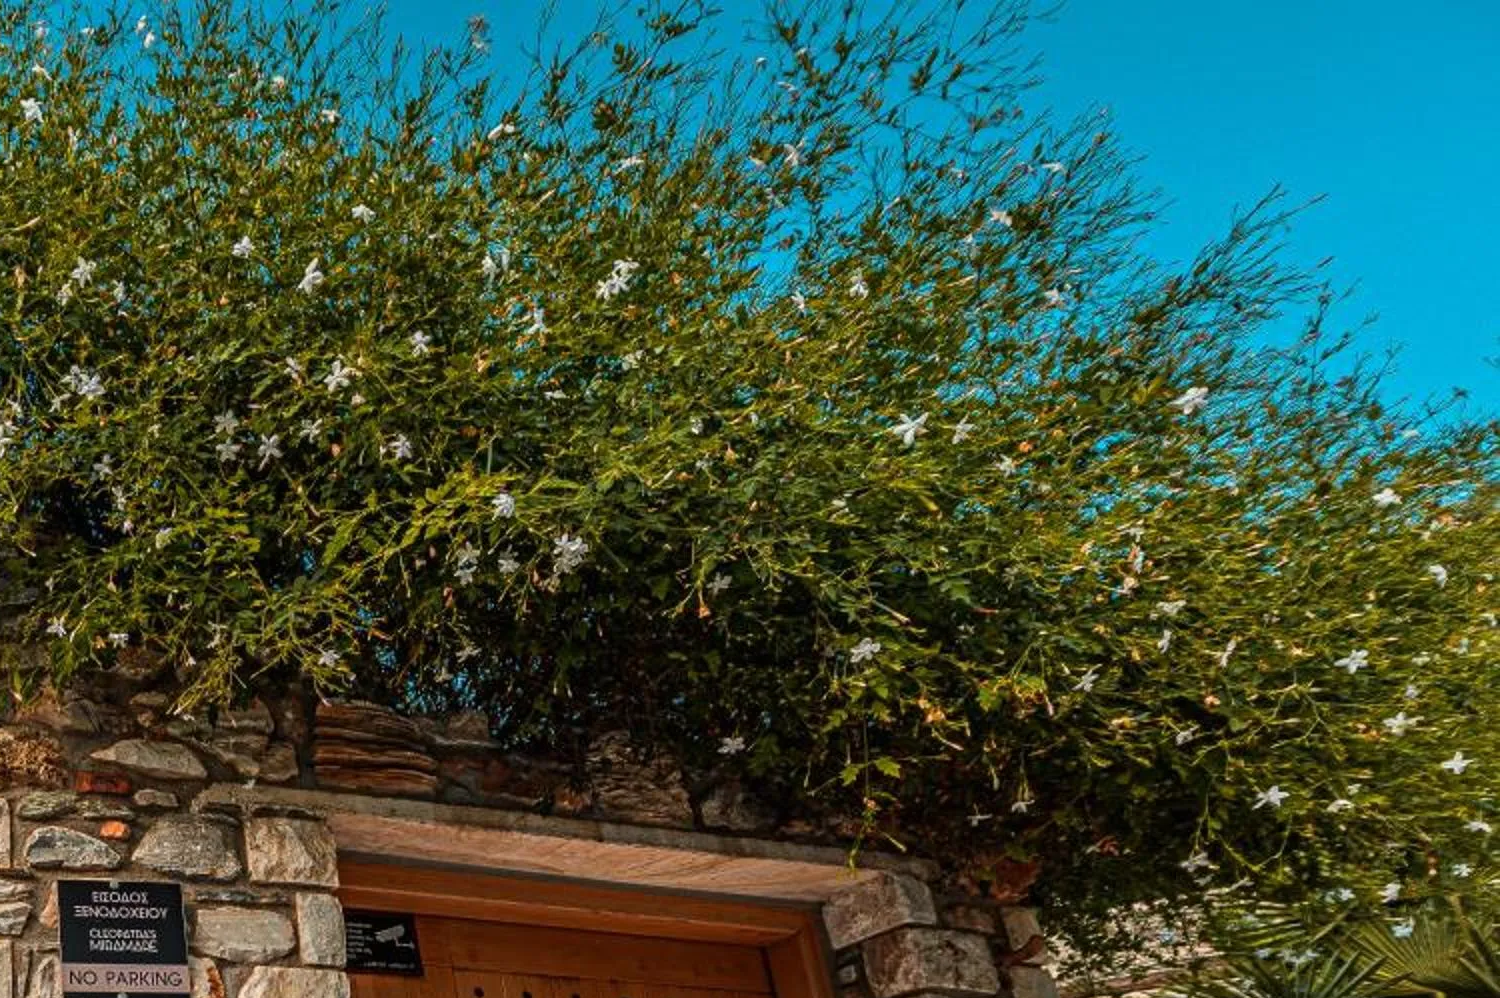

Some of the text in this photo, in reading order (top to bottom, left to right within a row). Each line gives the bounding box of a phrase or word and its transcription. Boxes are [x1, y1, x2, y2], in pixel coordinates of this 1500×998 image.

[91, 891, 149, 904] ΕΙΣΟΔΟΣ
[74, 905, 168, 919] ΞΕΝΟΔΟΧΕΙΟΥ
[69, 970, 183, 988] NO PARKING
